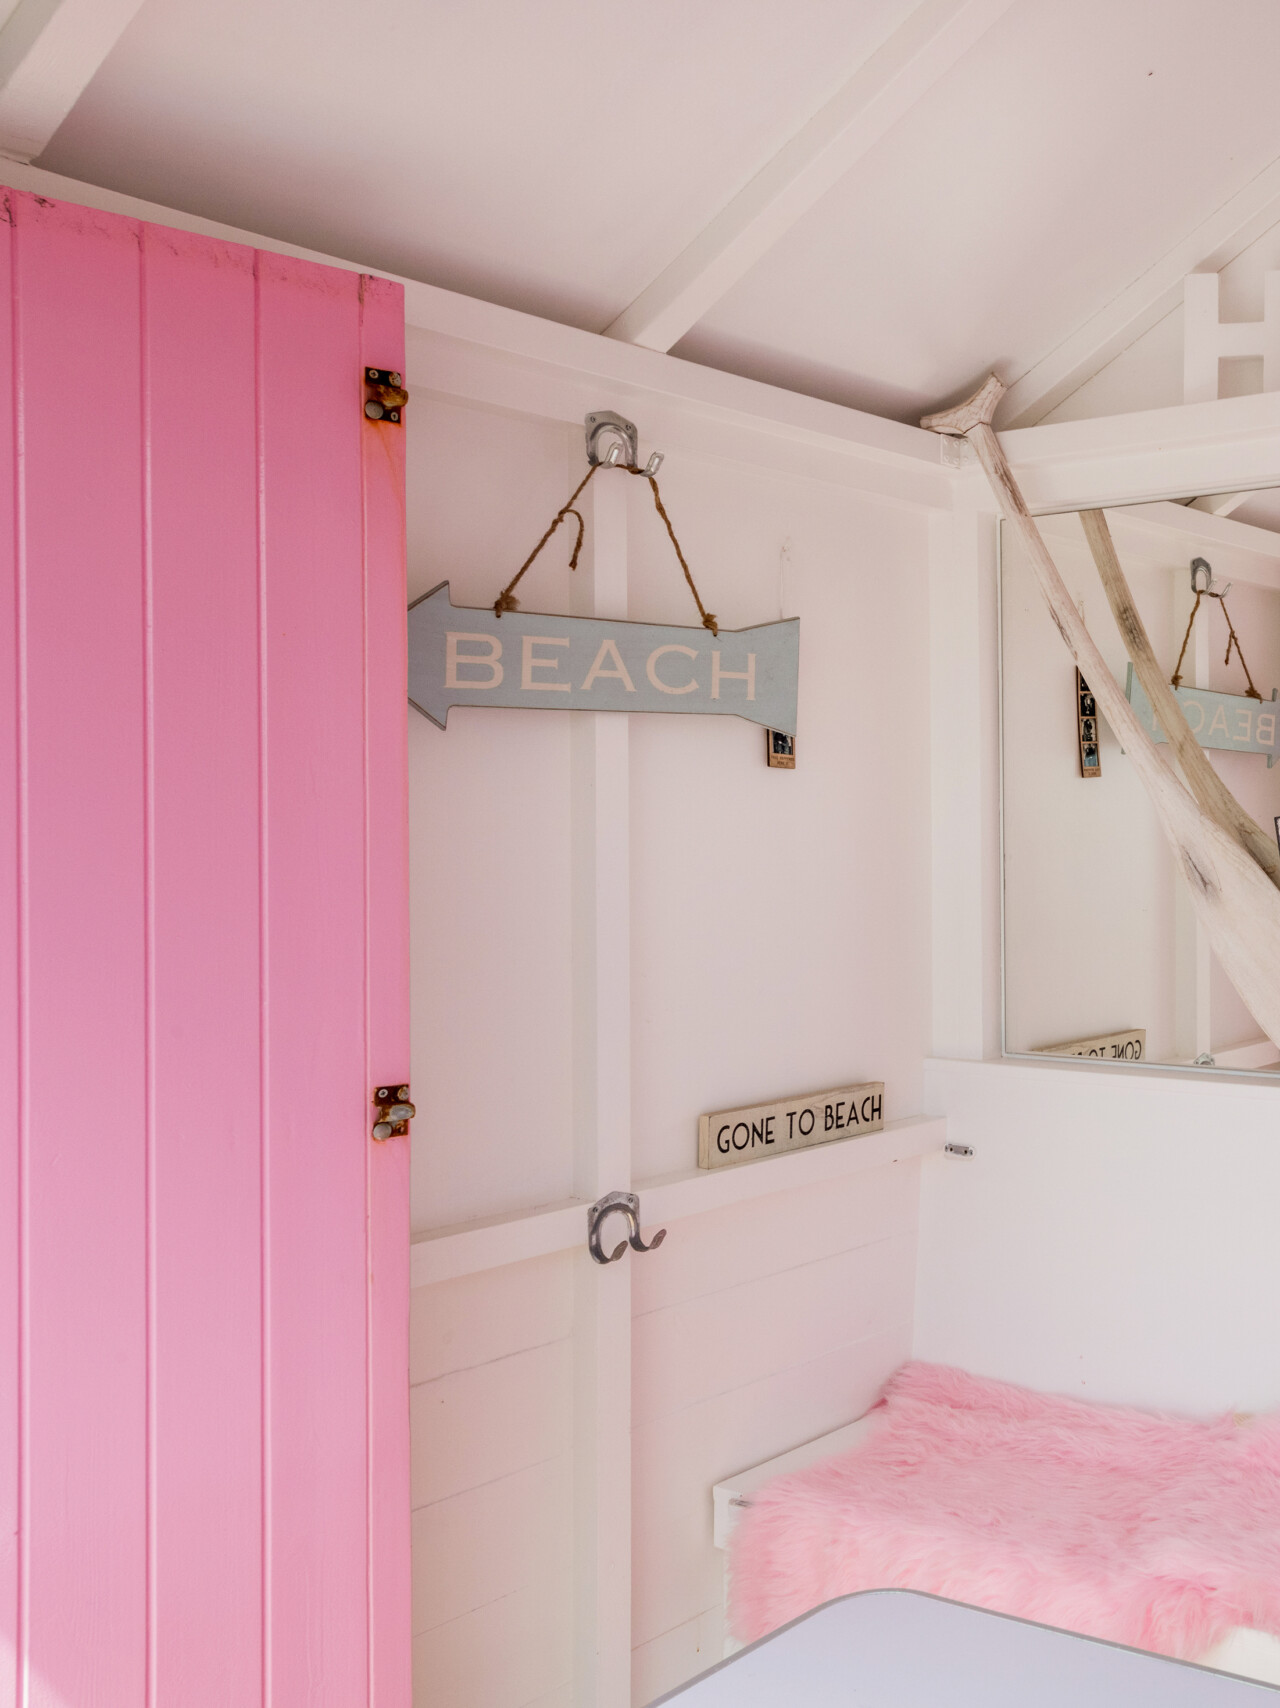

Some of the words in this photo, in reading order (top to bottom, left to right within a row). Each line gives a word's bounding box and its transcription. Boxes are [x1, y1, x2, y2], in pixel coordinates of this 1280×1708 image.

[444, 631, 757, 700] BEACH
[717, 1116, 775, 1153] GONE
[786, 1109, 815, 1138] TO
[824, 1094, 882, 1131] BEACH
